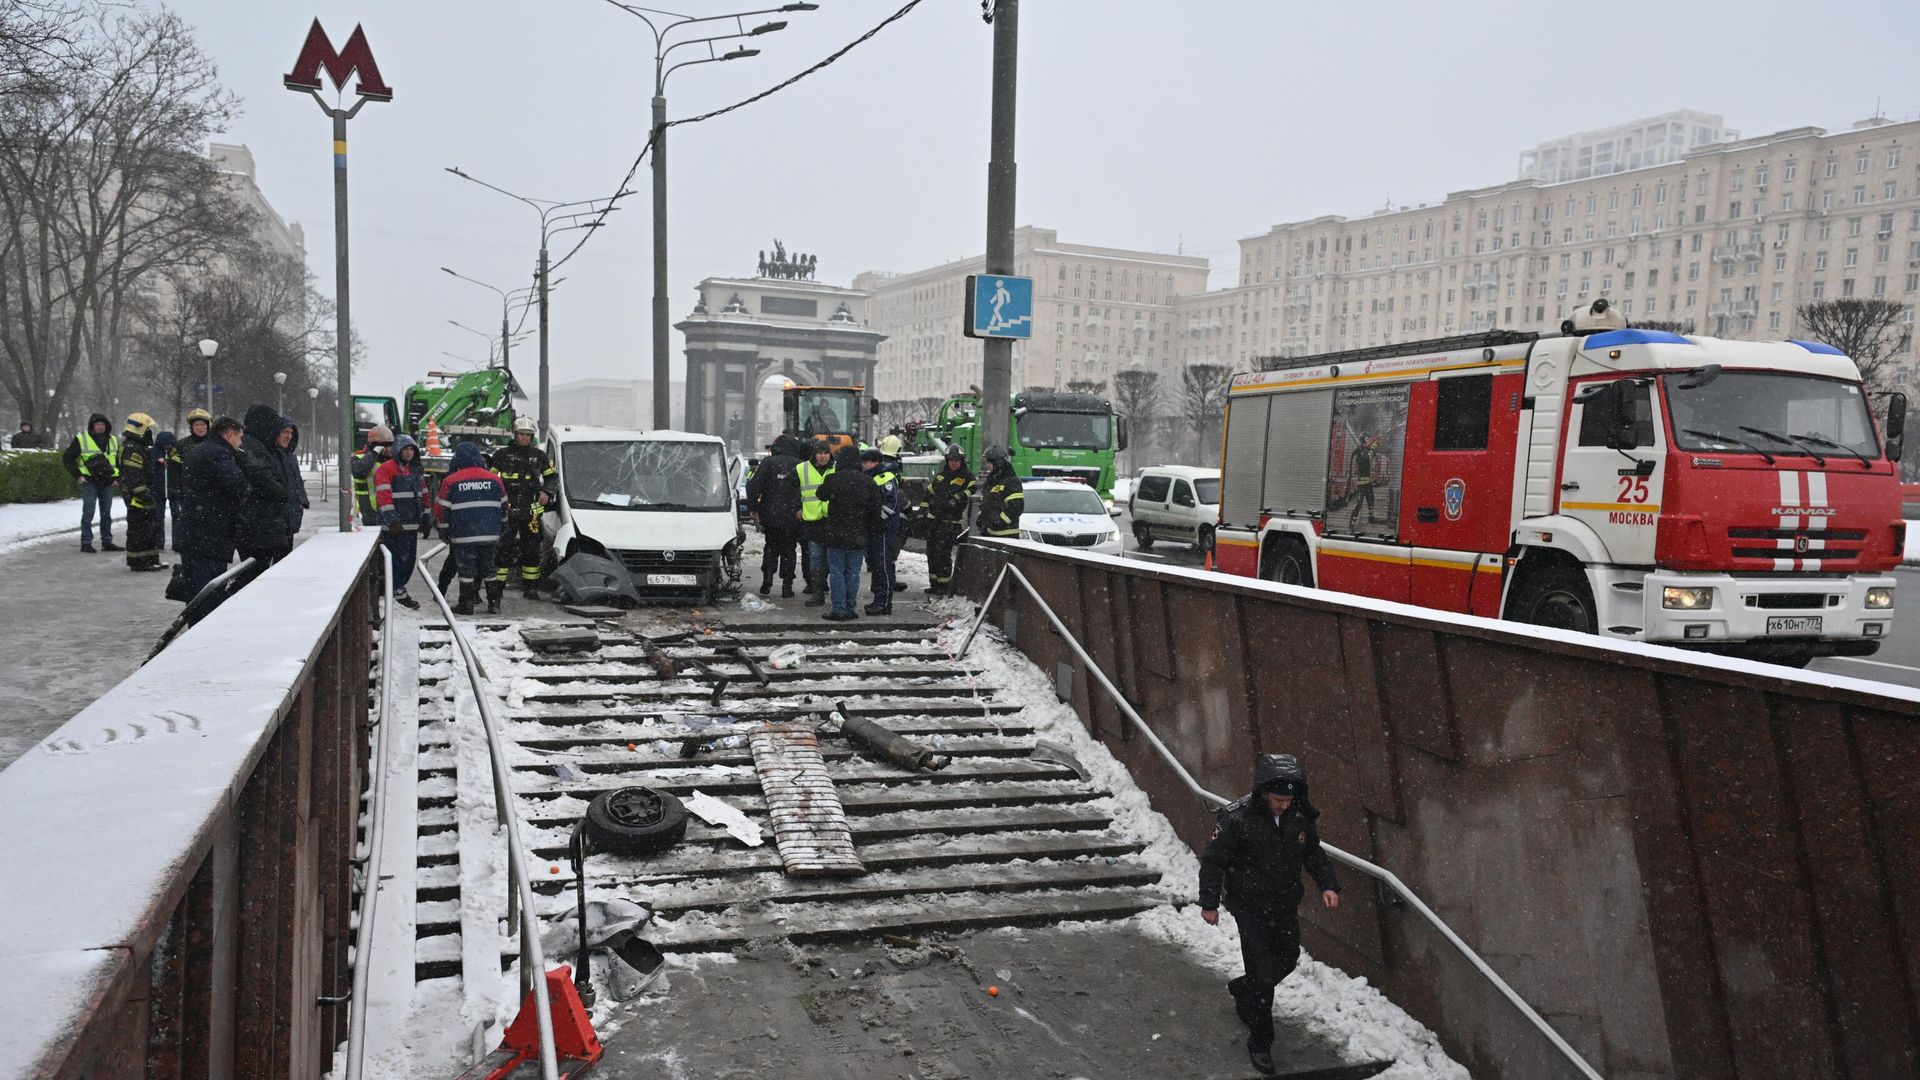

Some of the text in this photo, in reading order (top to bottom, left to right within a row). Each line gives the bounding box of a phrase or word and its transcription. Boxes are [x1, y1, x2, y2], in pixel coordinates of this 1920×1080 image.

[458, 481, 492, 491] ГОРМОСТ
[1616, 476, 1650, 503] 25
[1771, 507, 1837, 516] KAMAZ
[1609, 512, 1654, 526] МОСКВА
